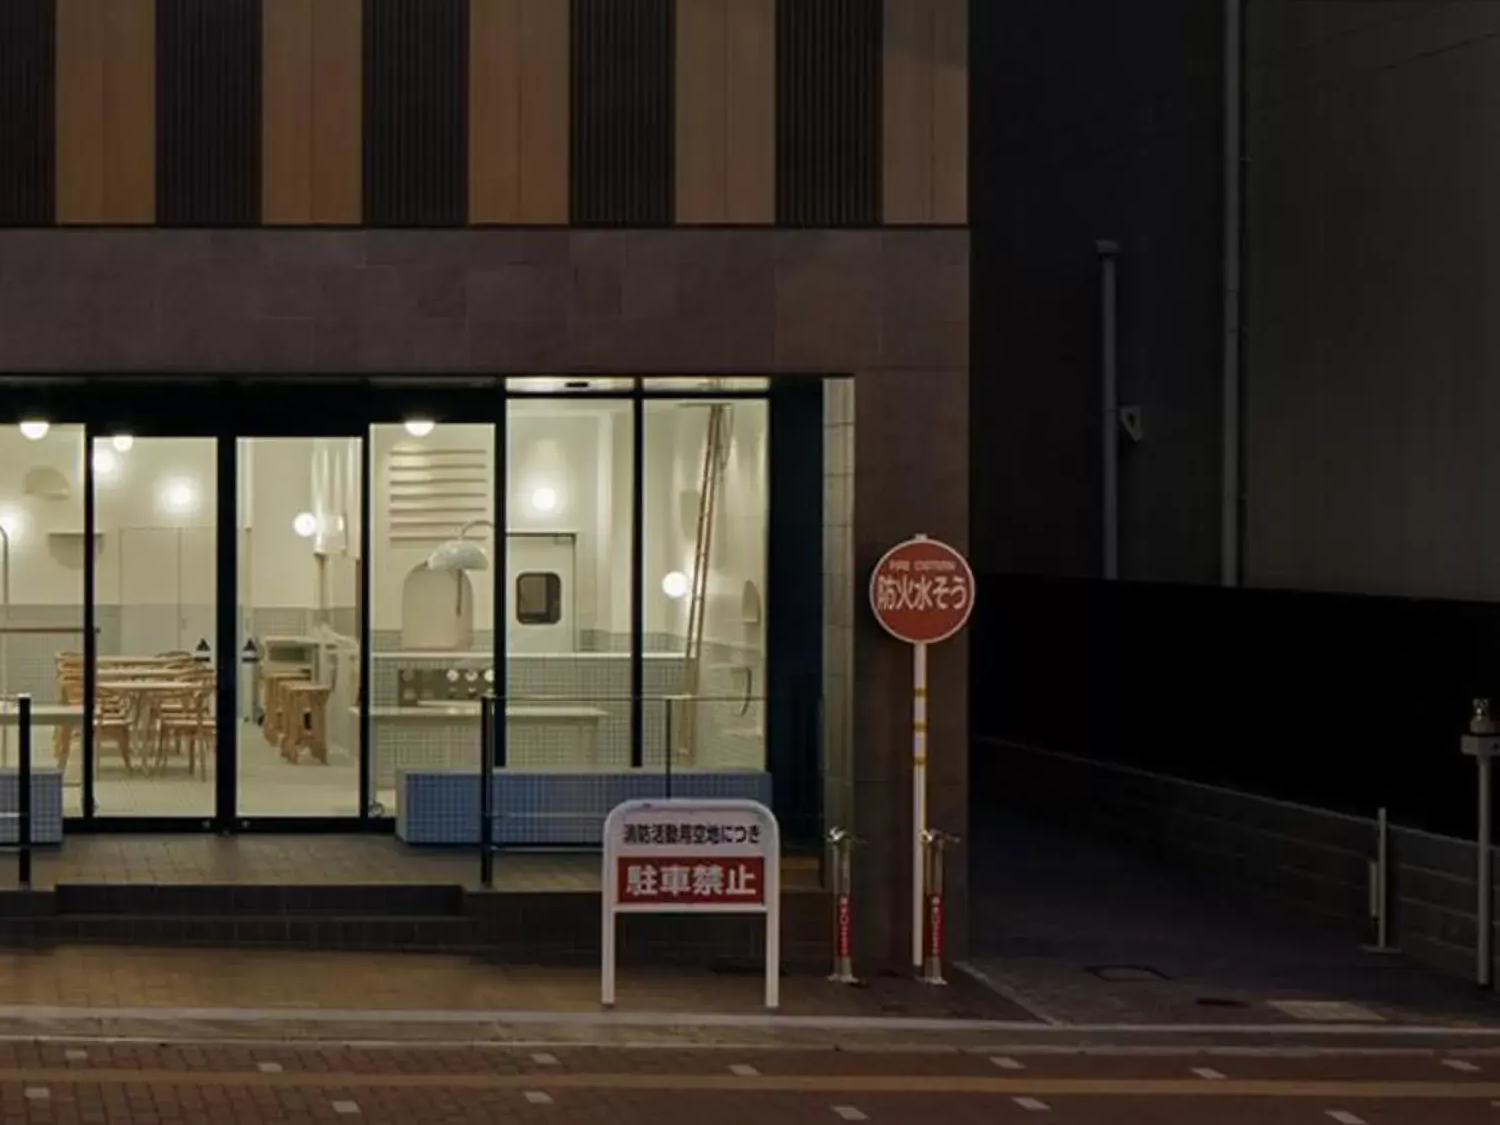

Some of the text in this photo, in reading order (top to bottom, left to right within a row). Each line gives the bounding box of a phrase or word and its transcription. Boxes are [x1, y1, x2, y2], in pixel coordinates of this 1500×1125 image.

[877, 575, 967, 611] 防火水そう
[626, 864, 757, 896] 駐車禁止
